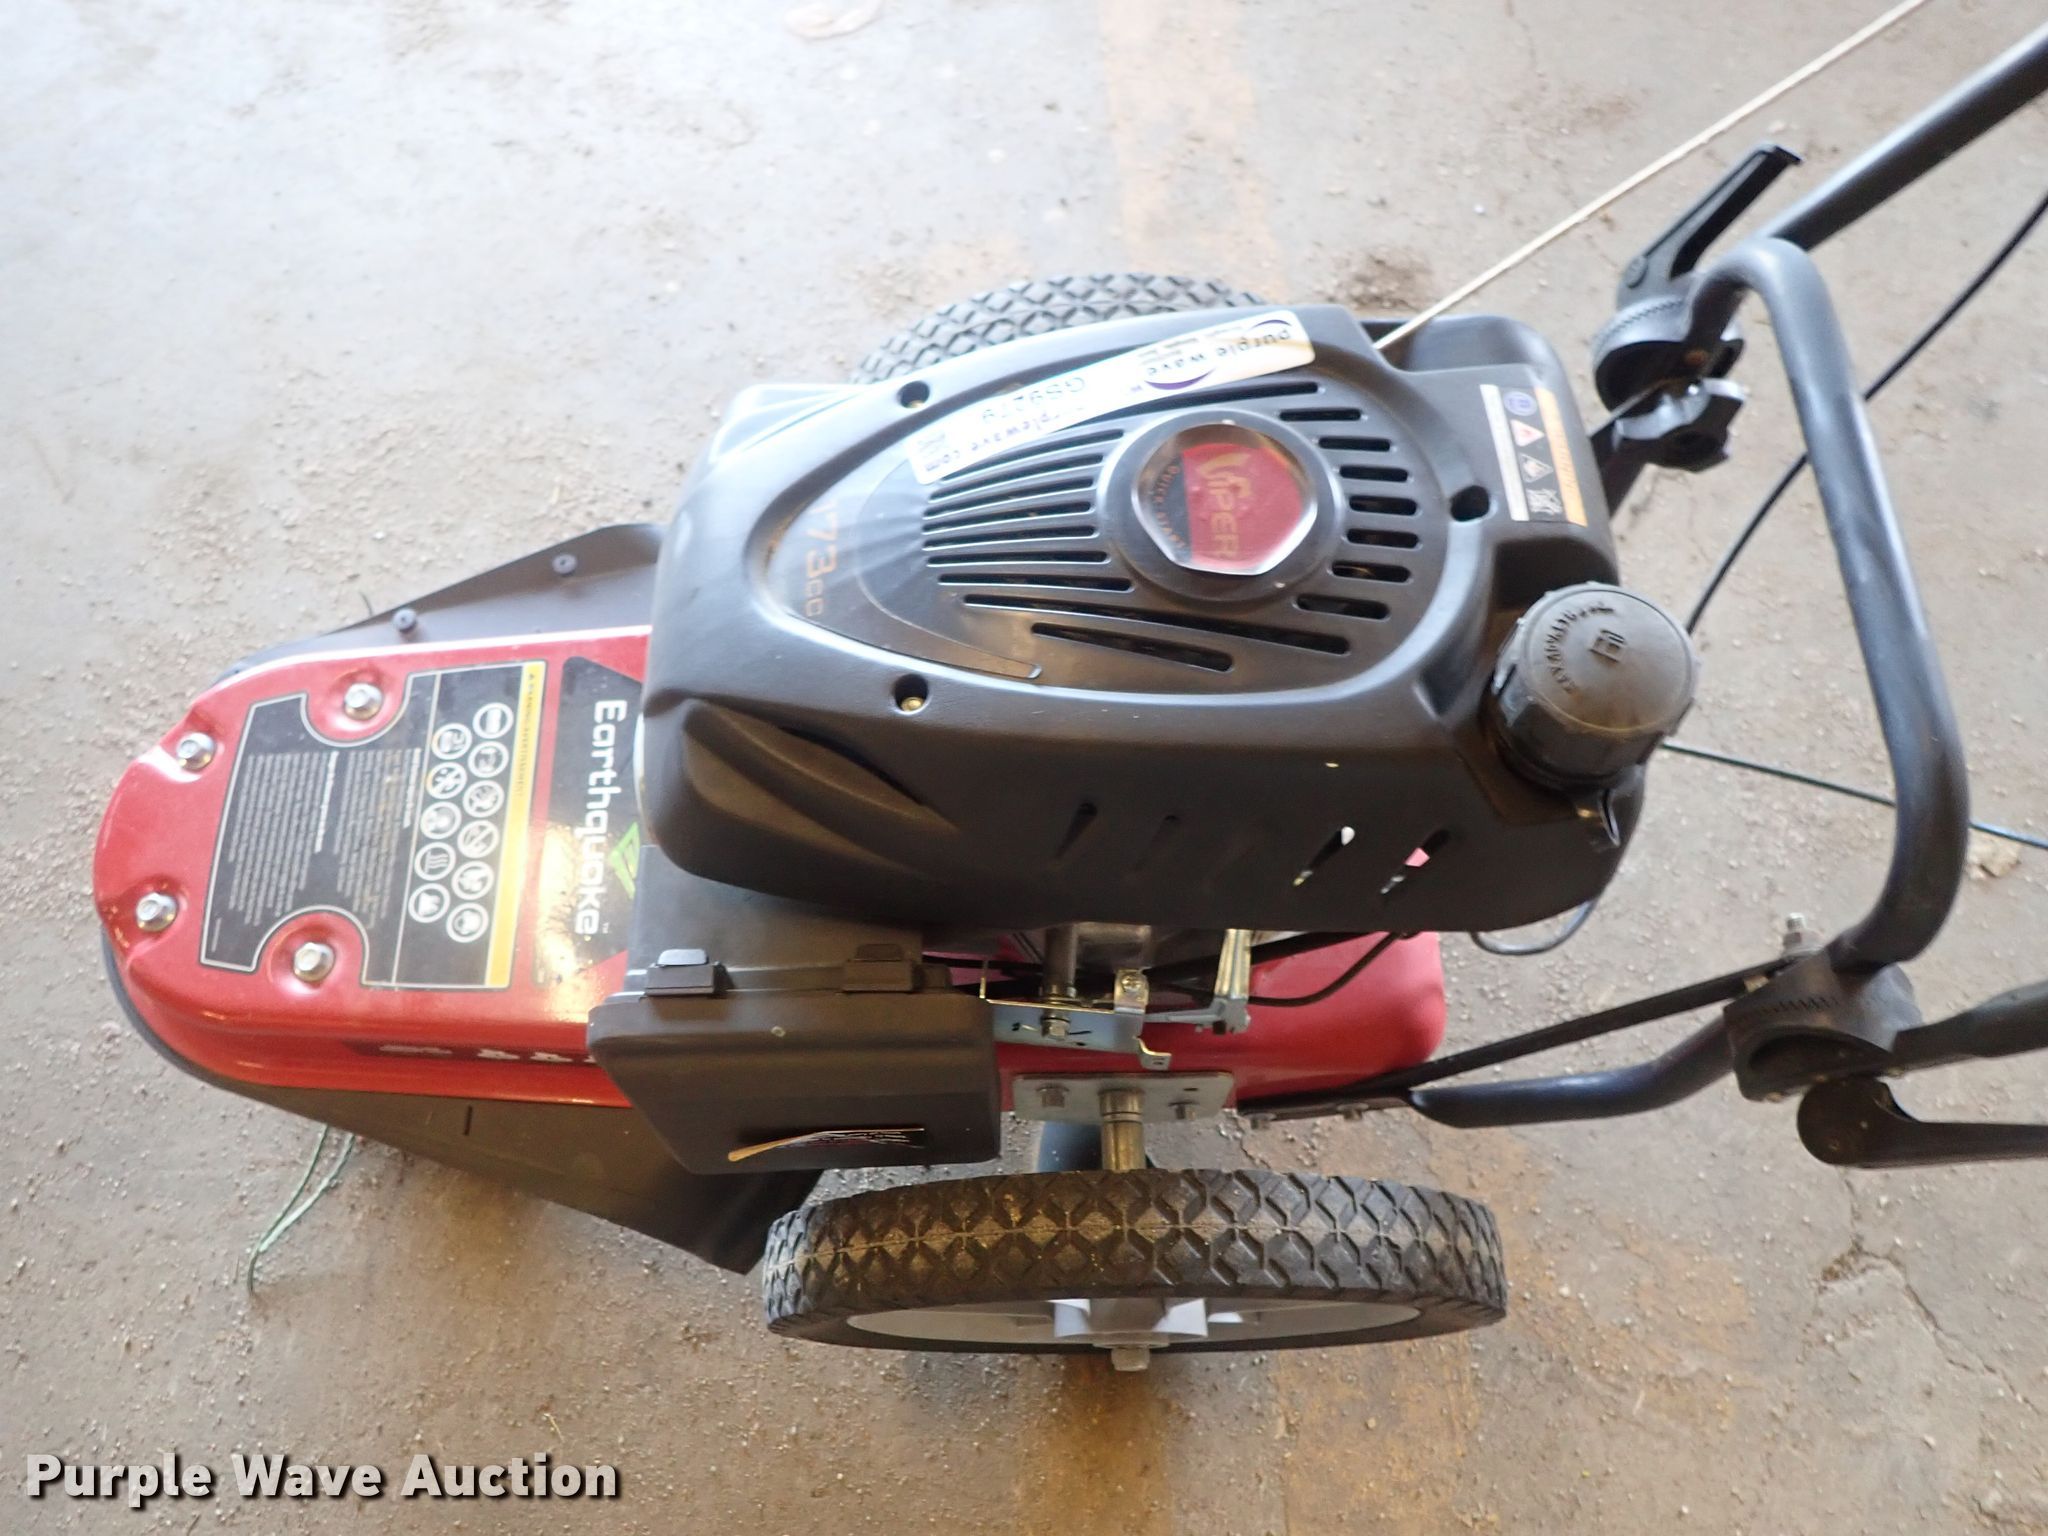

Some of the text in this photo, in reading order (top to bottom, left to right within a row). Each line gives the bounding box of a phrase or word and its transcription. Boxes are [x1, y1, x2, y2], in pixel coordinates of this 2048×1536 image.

[1153, 464, 1182, 503] QUICK
[1199, 452, 1254, 560] VIPER
[574, 699, 628, 935] Earthquake
